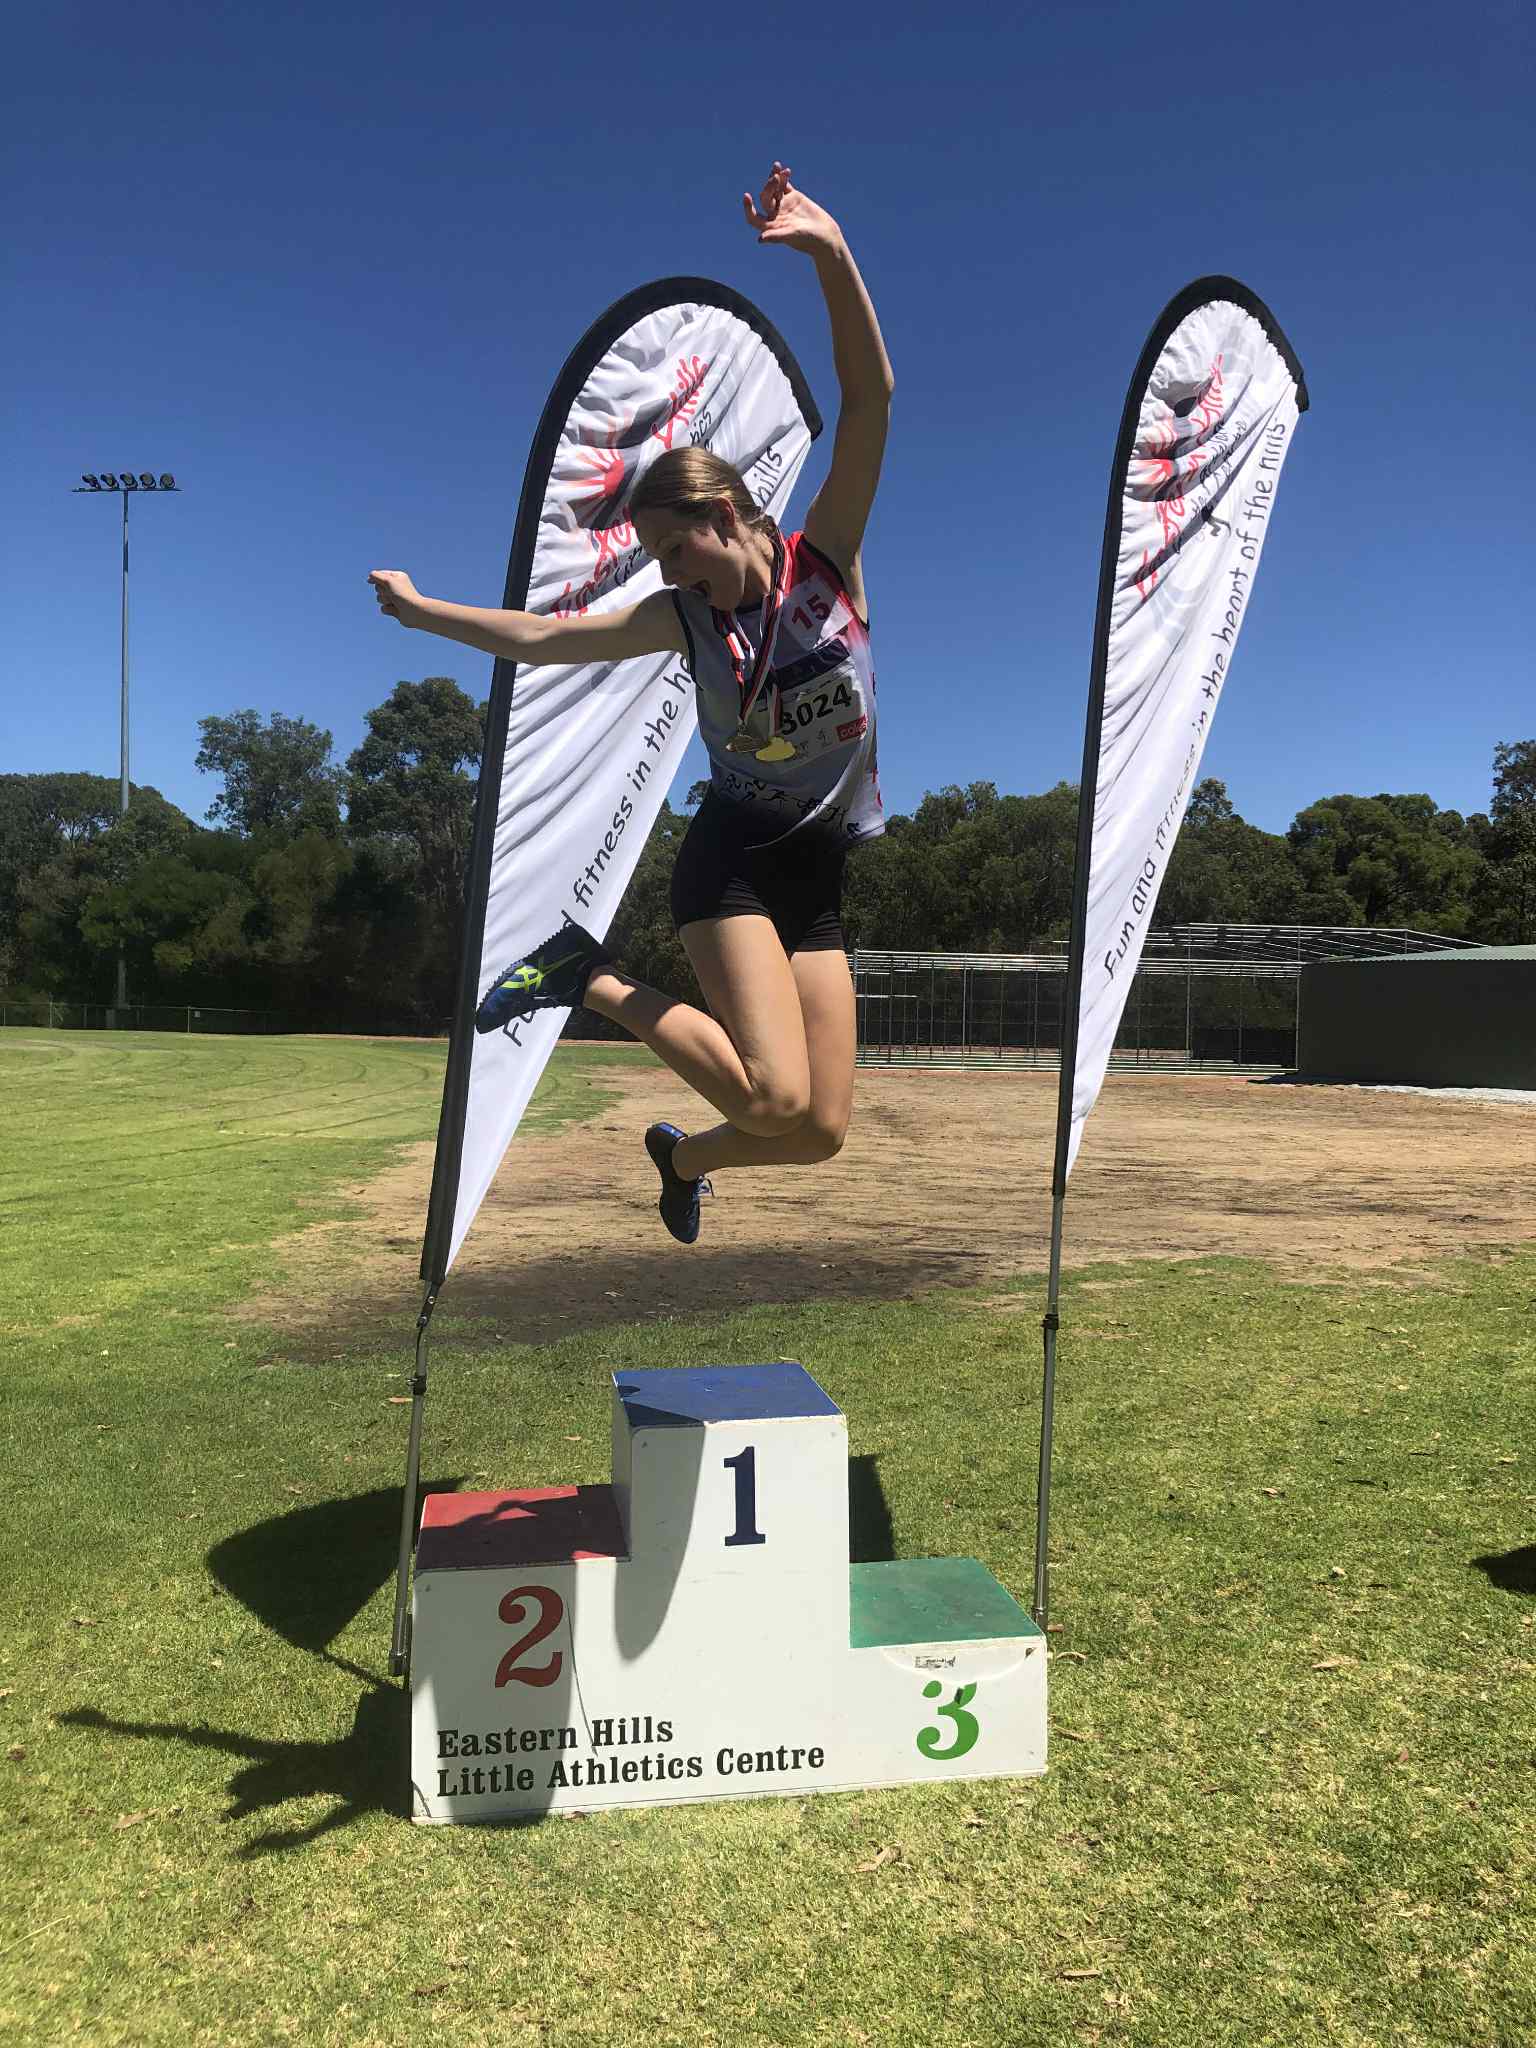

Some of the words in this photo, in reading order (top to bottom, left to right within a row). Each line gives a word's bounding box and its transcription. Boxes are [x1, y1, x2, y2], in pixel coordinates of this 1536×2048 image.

[1243, 480, 1274, 520] the
[1235, 527, 1260, 562] of
[791, 595, 832, 631] 15
[1200, 653, 1226, 700] the
[503, 1008, 535, 1047] Fu
[573, 796, 634, 908] fitness
[626, 760, 651, 793] in
[644, 699, 679, 754] the
[750, 446, 784, 509] hills
[1103, 918, 1135, 980] Fun
[724, 1446, 767, 1546] 1
[494, 1585, 564, 1688] 2
[436, 1726, 579, 1759] Eastern
[591, 1716, 674, 1748] Hills
[916, 1679, 980, 1761] 3
[436, 1763, 535, 1798] Little
[546, 1752, 704, 1789] Athletics
[716, 1745, 826, 1776] Centre
